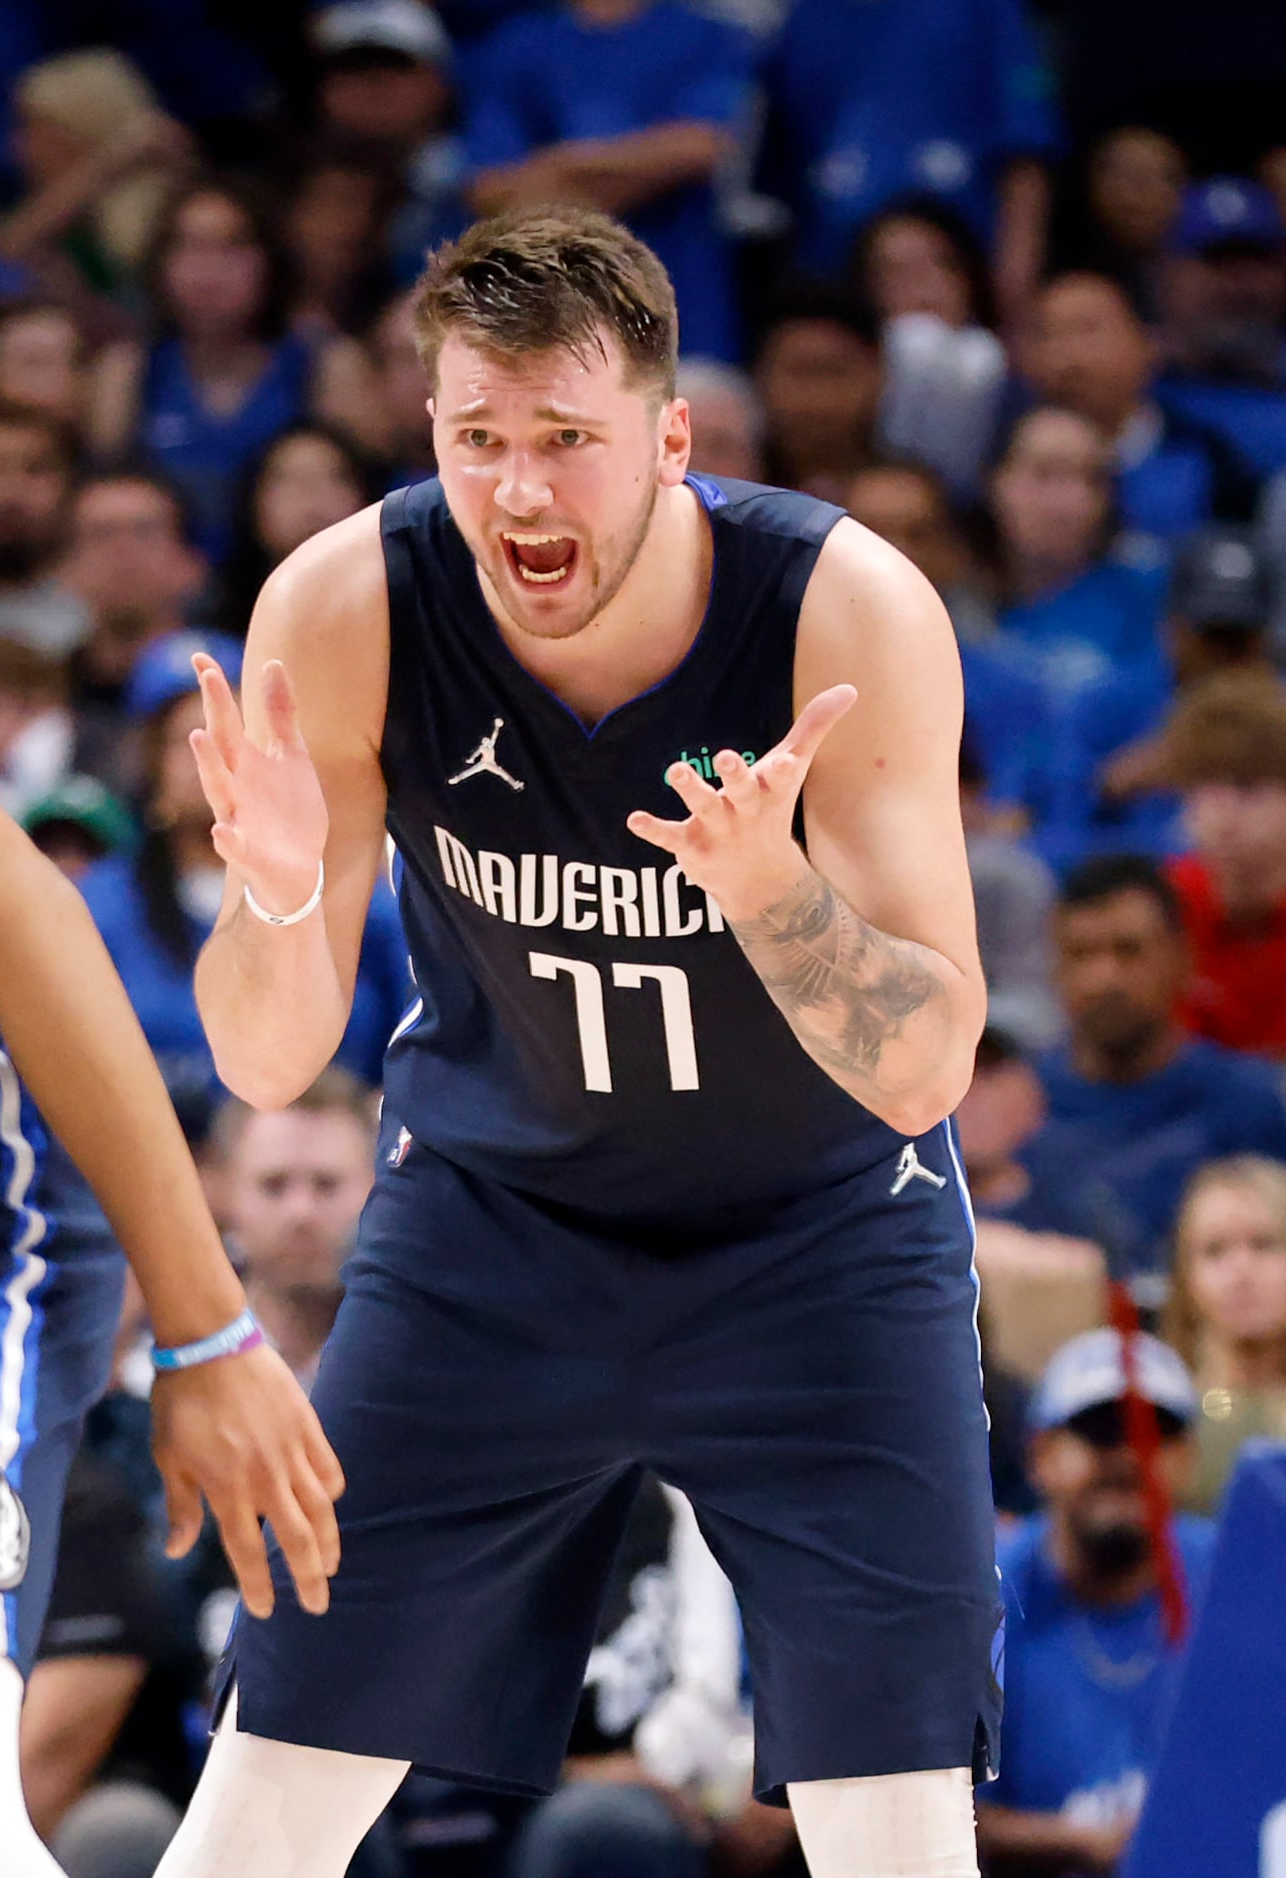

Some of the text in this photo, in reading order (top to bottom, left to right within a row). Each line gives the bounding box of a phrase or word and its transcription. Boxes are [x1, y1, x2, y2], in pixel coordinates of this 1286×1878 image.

[664, 746, 756, 787] hie
[434, 825, 725, 937] MAVERIC
[528, 951, 700, 1093] 77
